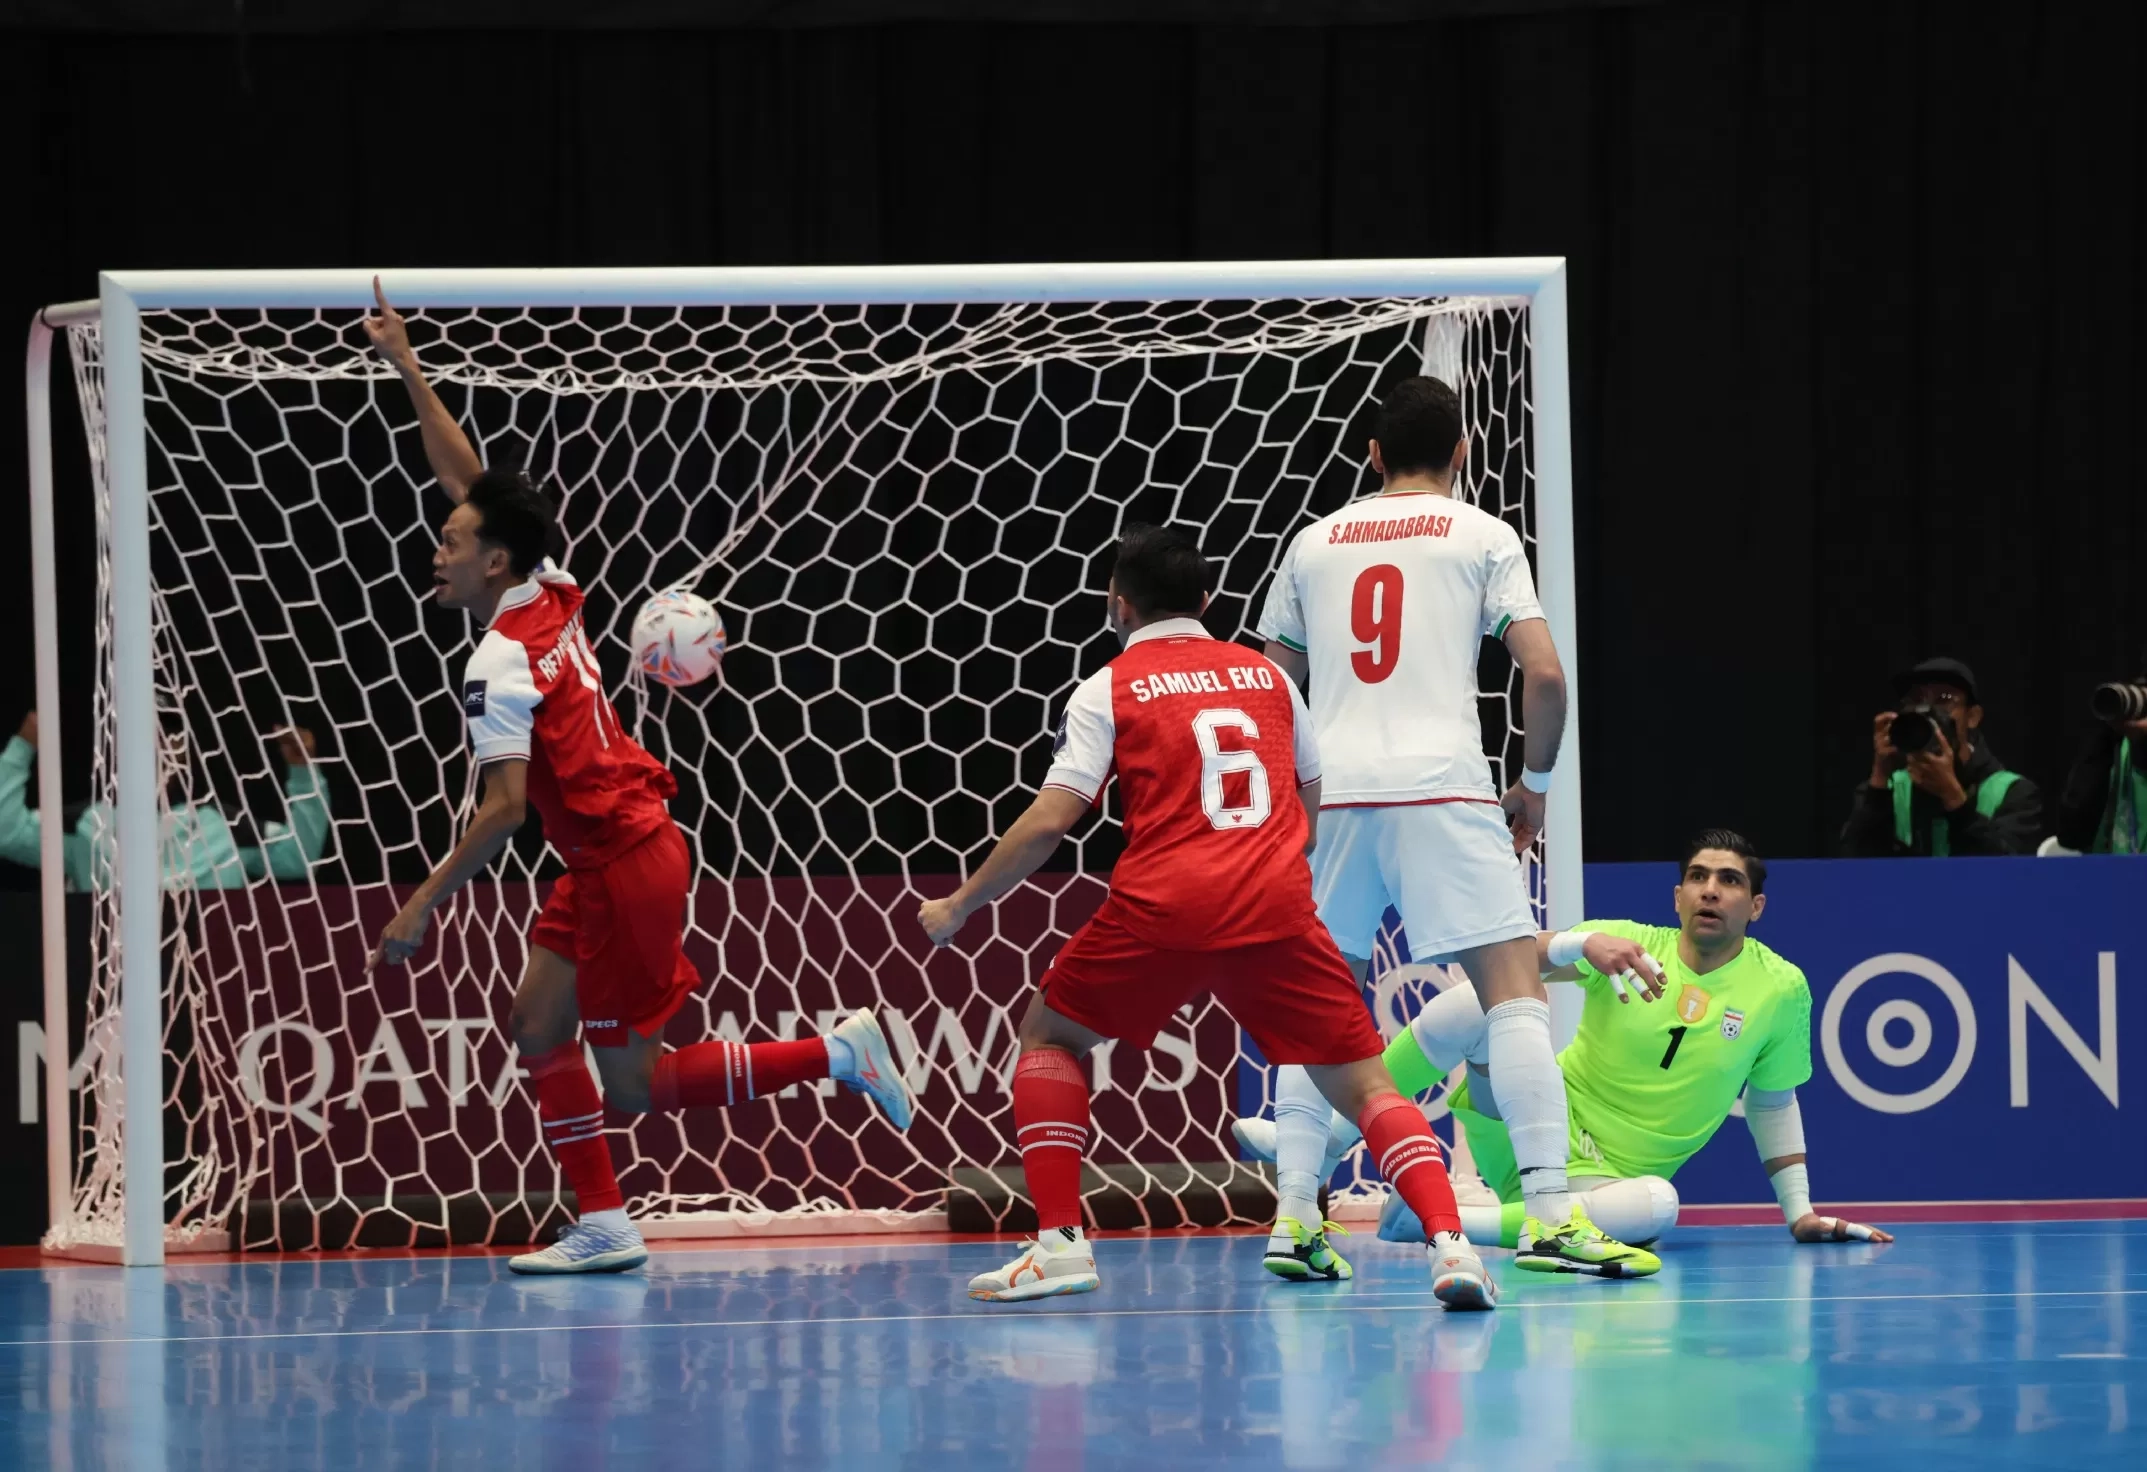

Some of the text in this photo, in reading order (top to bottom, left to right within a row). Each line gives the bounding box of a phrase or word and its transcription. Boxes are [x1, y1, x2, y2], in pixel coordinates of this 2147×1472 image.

[1328, 514, 1453, 545] S.AHMADABBASI
[1350, 563, 1405, 684] 9
[1130, 666, 1274, 703] SAMUEL EKO
[1191, 708, 1272, 831] 6
[1659, 1025, 1688, 1070] 1
[1384, 1145, 1439, 1178] INDONESIA
